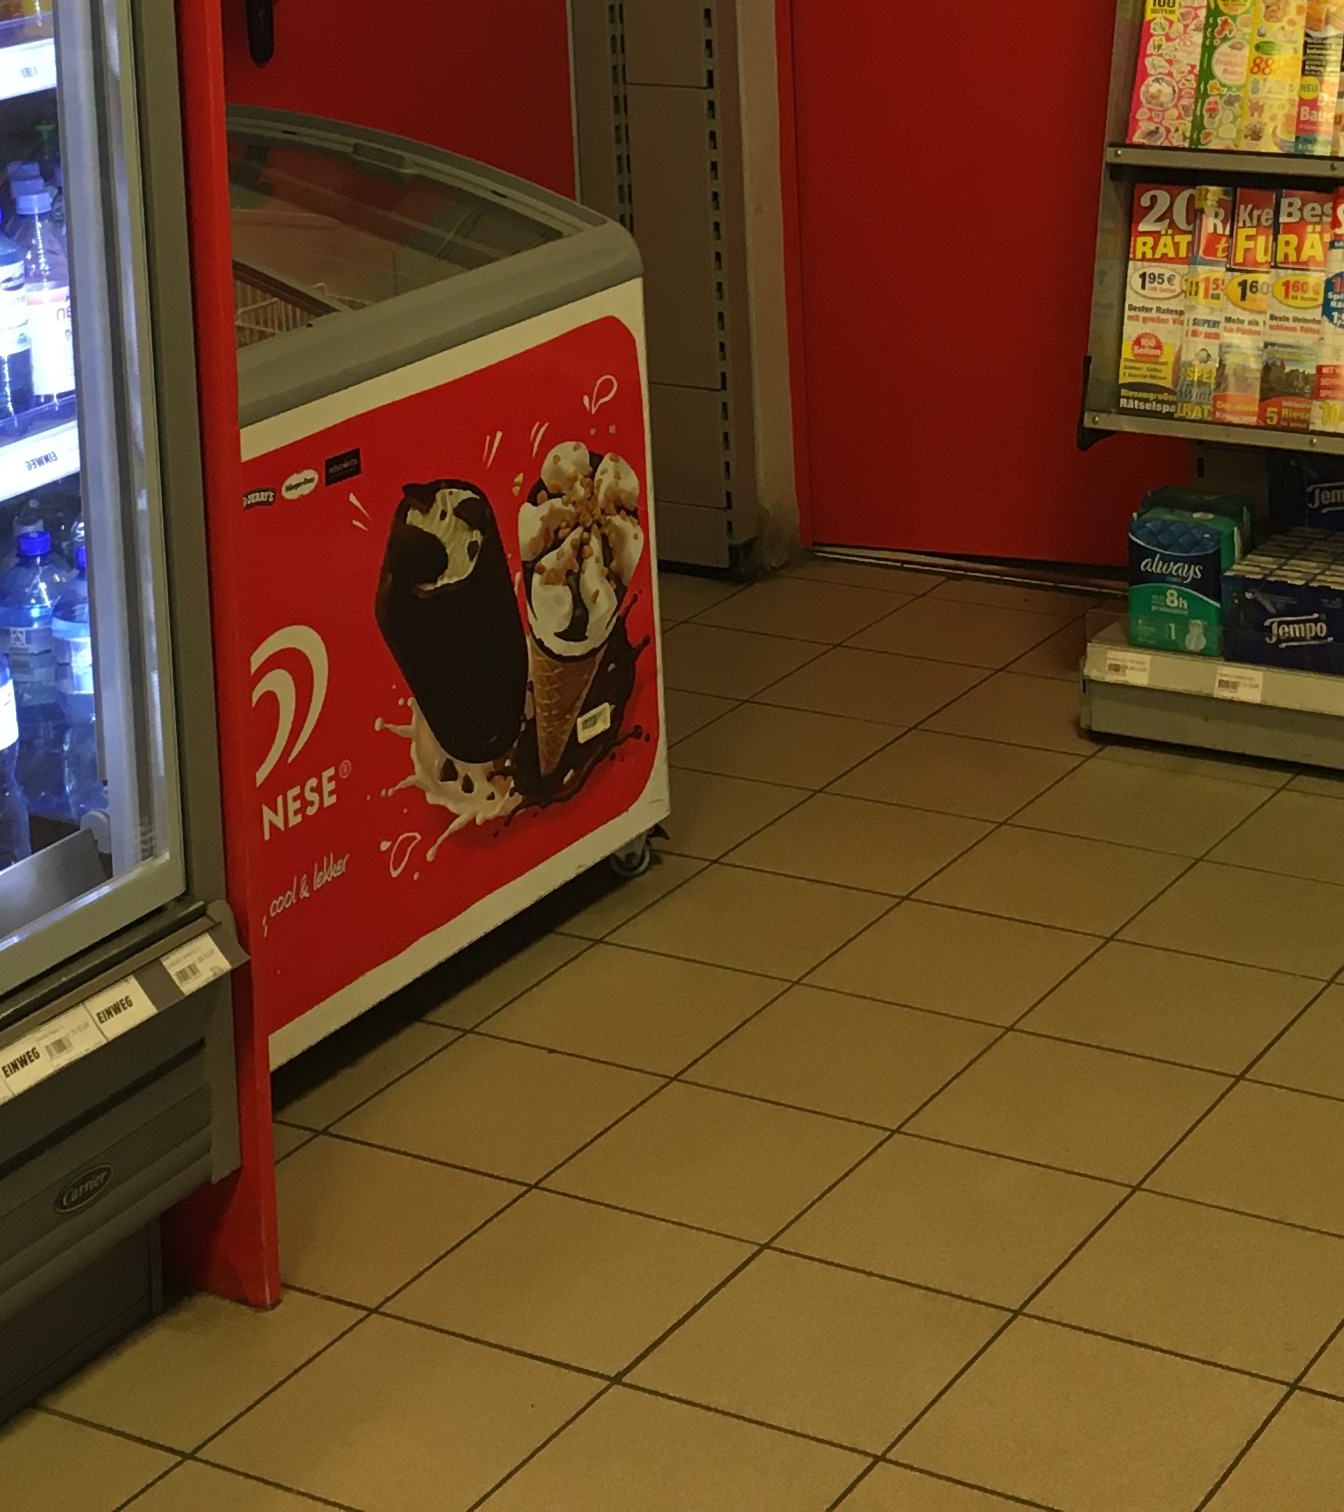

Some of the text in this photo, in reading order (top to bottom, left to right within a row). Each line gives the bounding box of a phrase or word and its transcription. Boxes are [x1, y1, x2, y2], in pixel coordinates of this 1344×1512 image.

[1140, 554, 1204, 583] always
[1165, 589, 1188, 610] 8h
[1266, 620, 1327, 643] Tempo
[261, 766, 338, 842] NESE
[96, 995, 134, 1025] EINWEG
[1, 1047, 41, 1079] EINWEG
[62, 1170, 108, 1208] Carrier
